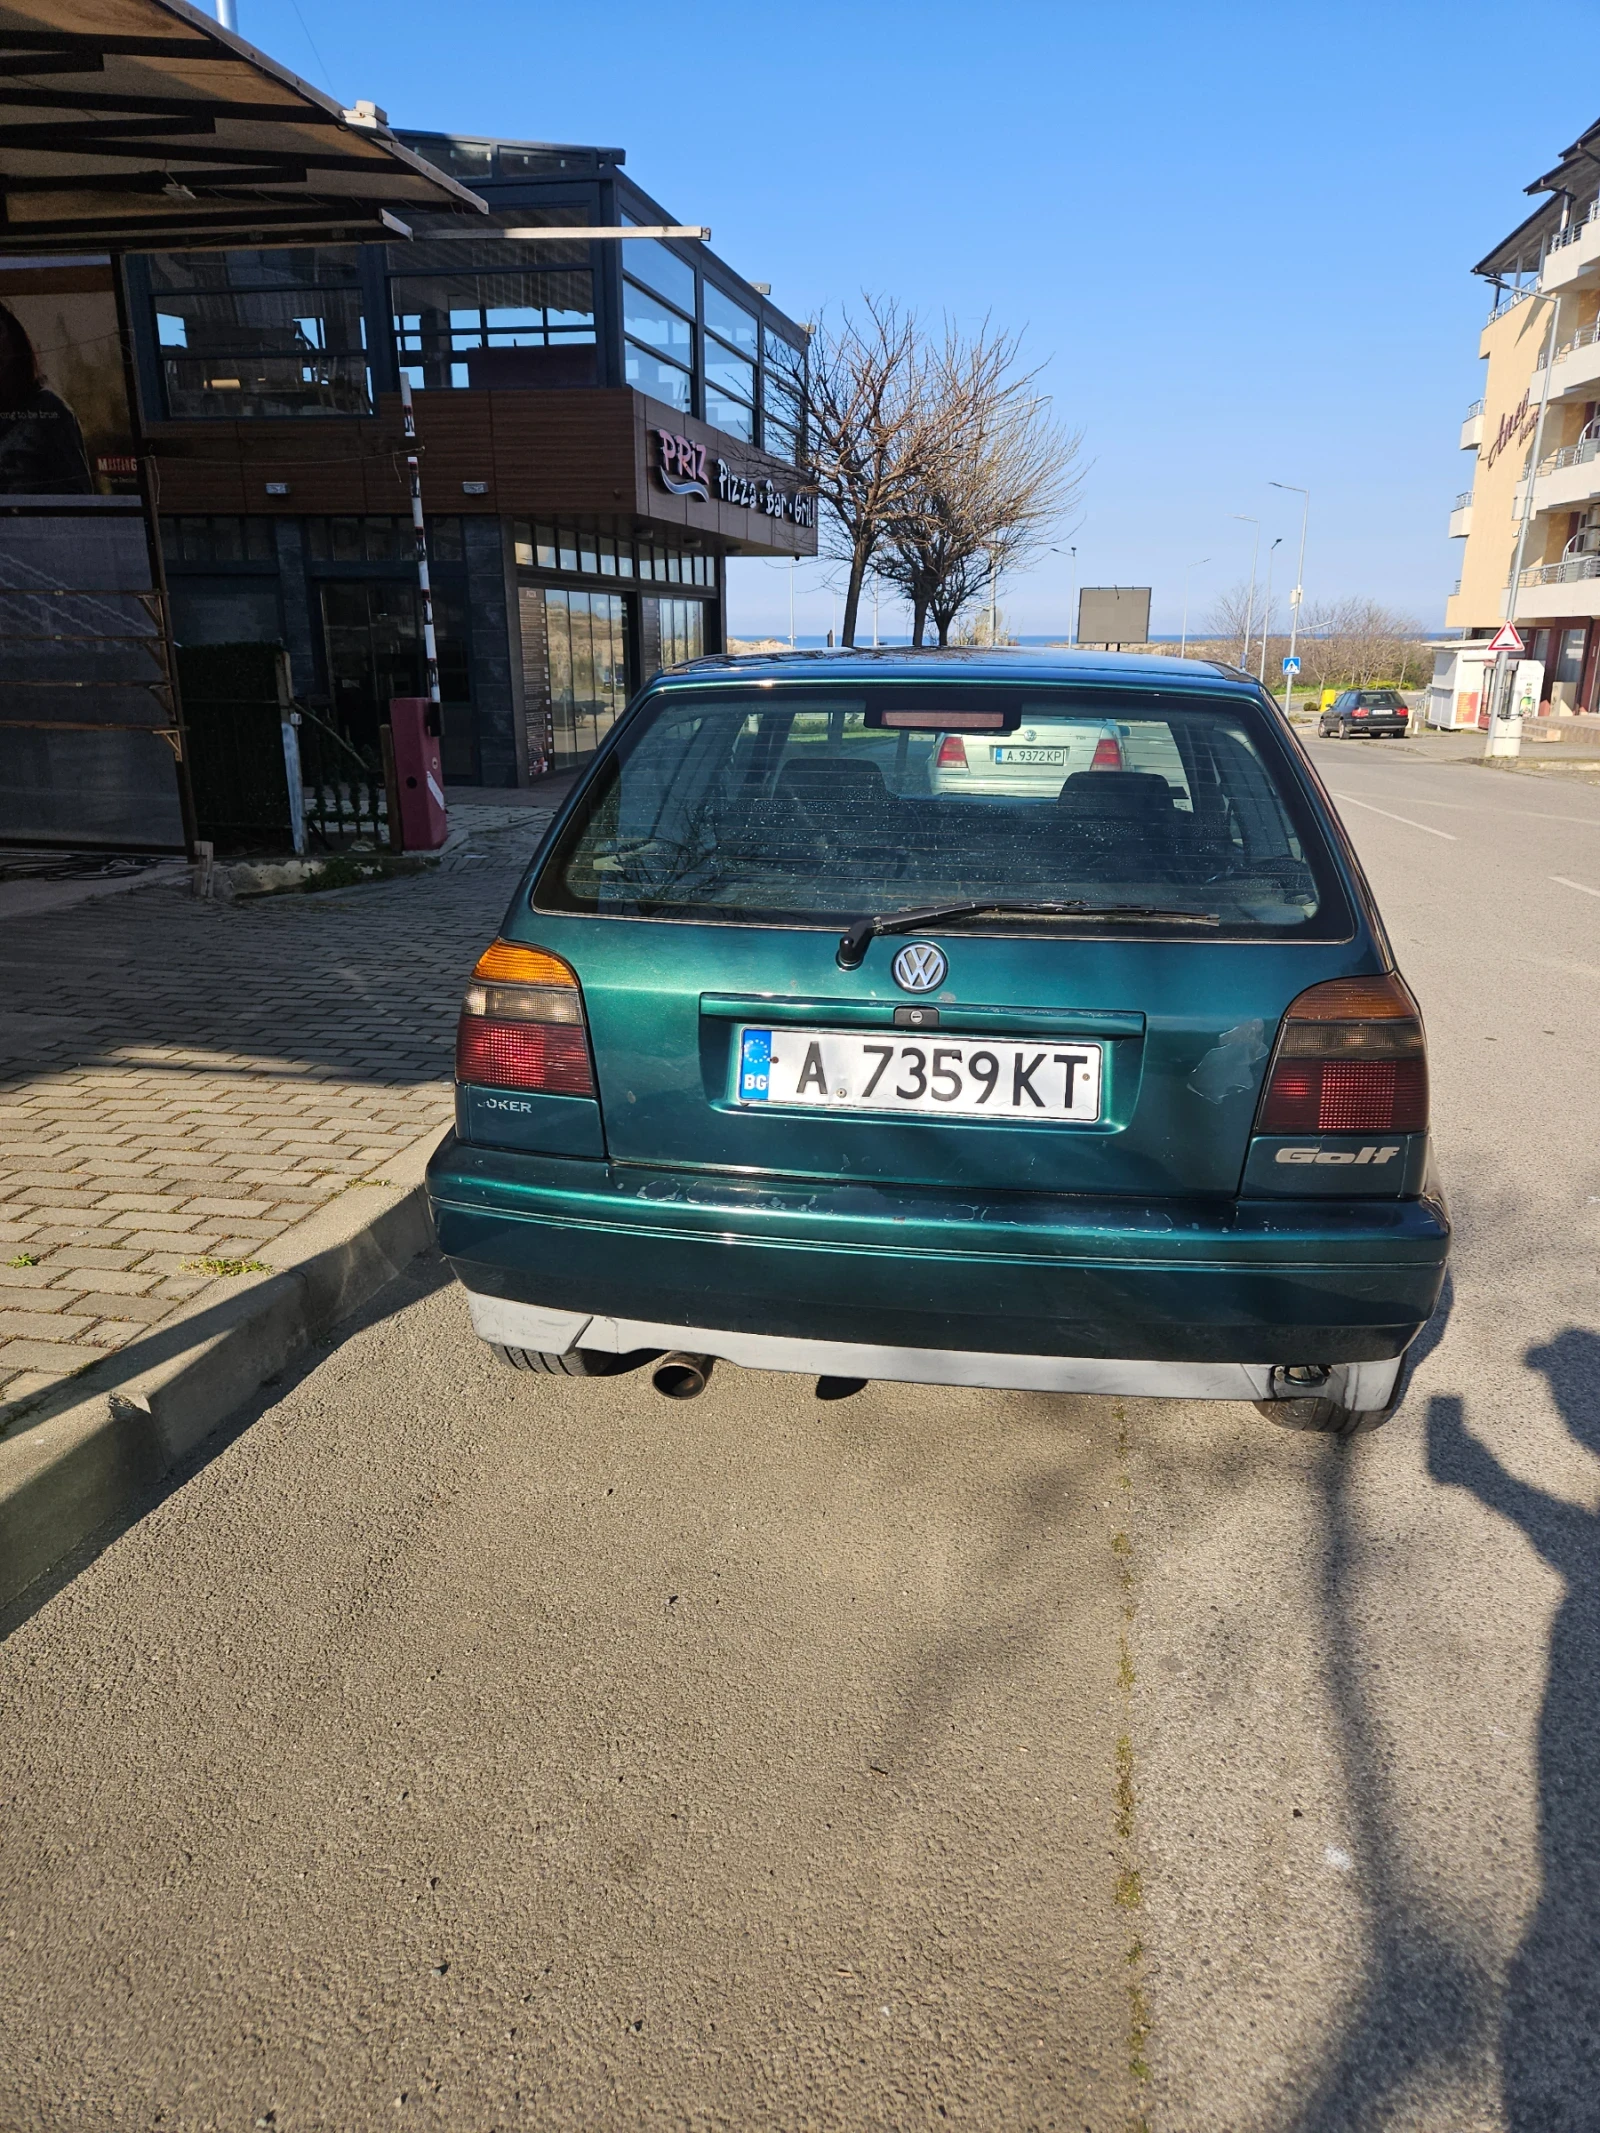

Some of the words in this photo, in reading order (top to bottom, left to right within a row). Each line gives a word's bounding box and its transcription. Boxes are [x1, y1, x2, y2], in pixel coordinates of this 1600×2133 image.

[717, 458, 757, 509] Pizza
[765, 479, 787, 519] Bar
[744, 1073, 767, 1091] BG
[796, 1040, 828, 1095] A
[1275, 1146, 1401, 1164] Golf
